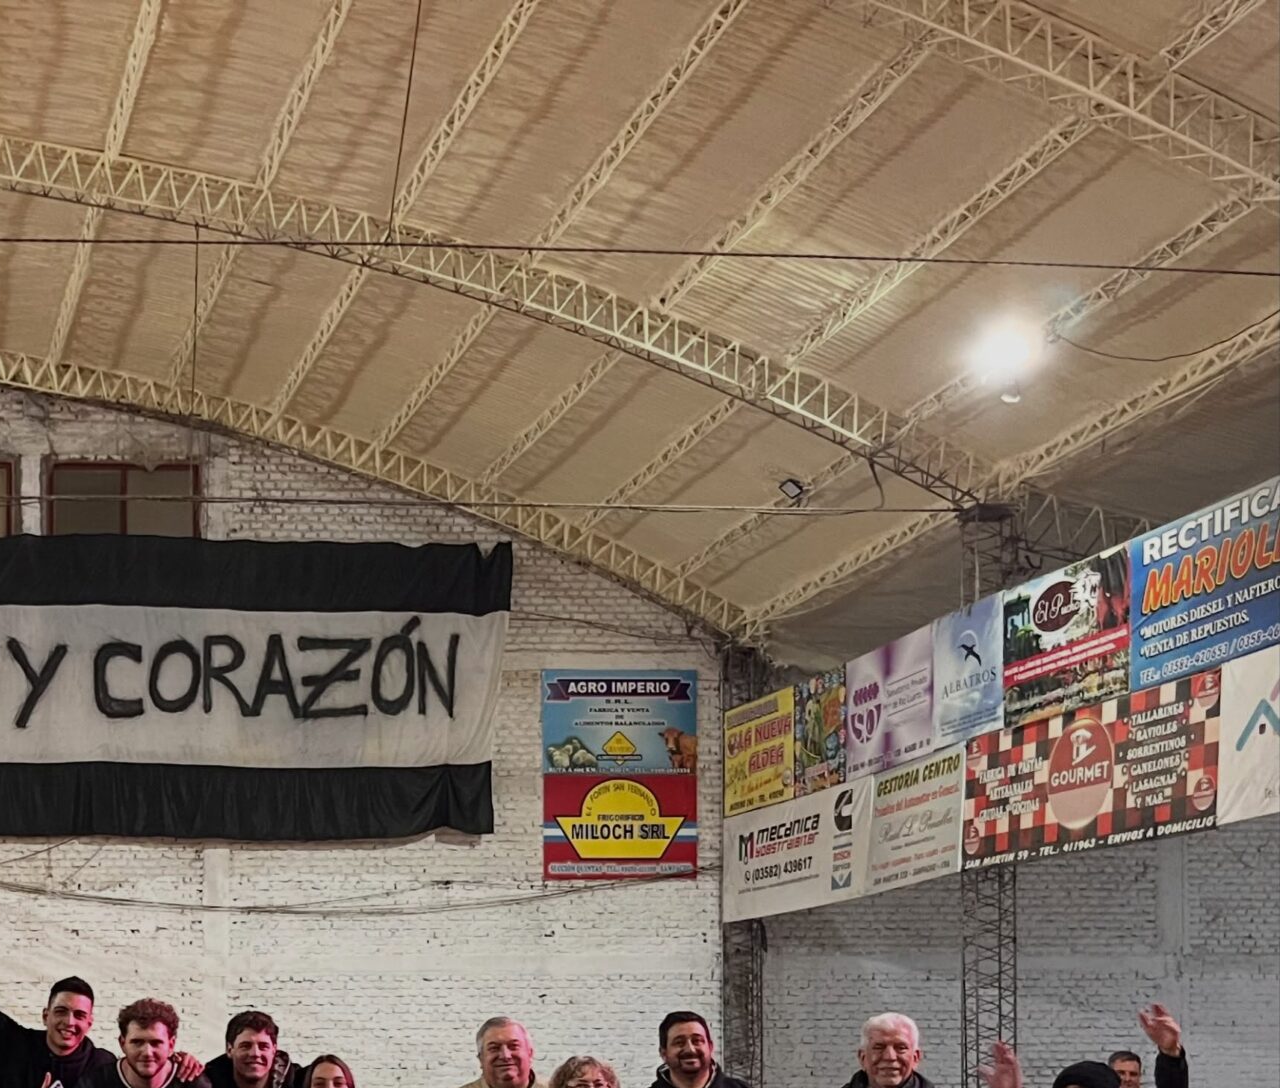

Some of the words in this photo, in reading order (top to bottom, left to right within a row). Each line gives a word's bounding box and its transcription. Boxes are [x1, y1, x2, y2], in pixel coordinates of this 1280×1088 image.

[1144, 611, 1190, 639] MOTORES
[1191, 598, 1225, 624] DIESEL
[1226, 594, 1234, 607] Y
[1144, 638, 1174, 658] VENTA
[1176, 631, 1191, 647] DE
[7, 636, 69, 729] Y
[93, 616, 460, 721] CORAZÓN
[943, 666, 997, 699] ALBATROS
[568, 681, 607, 693] AGRO
[611, 681, 671, 693] IMPERIO
[1131, 702, 1185, 726] TALLARINES
[755, 714, 792, 743] NUEVA
[1135, 720, 1178, 742] RAVIOLES
[749, 744, 784, 773] ALDEA
[1126, 735, 1187, 761] SORRENTINOS
[877, 768, 919, 797] GESTORIA
[922, 753, 961, 782] CENTRO
[1051, 761, 1110, 787] GOURMET
[1130, 754, 1181, 776] CANELONES
[572, 824, 633, 839] MILOCH
[639, 824, 670, 839] SRL
[965, 859, 980, 869] SAN
[982, 853, 1014, 866] MARTIN
[1107, 829, 1143, 845] ENVIOS
[1146, 826, 1154, 837] A
[1157, 817, 1214, 836] DOMICILIO
[753, 864, 781, 884] (03582)
[783, 856, 812, 874] 439617
